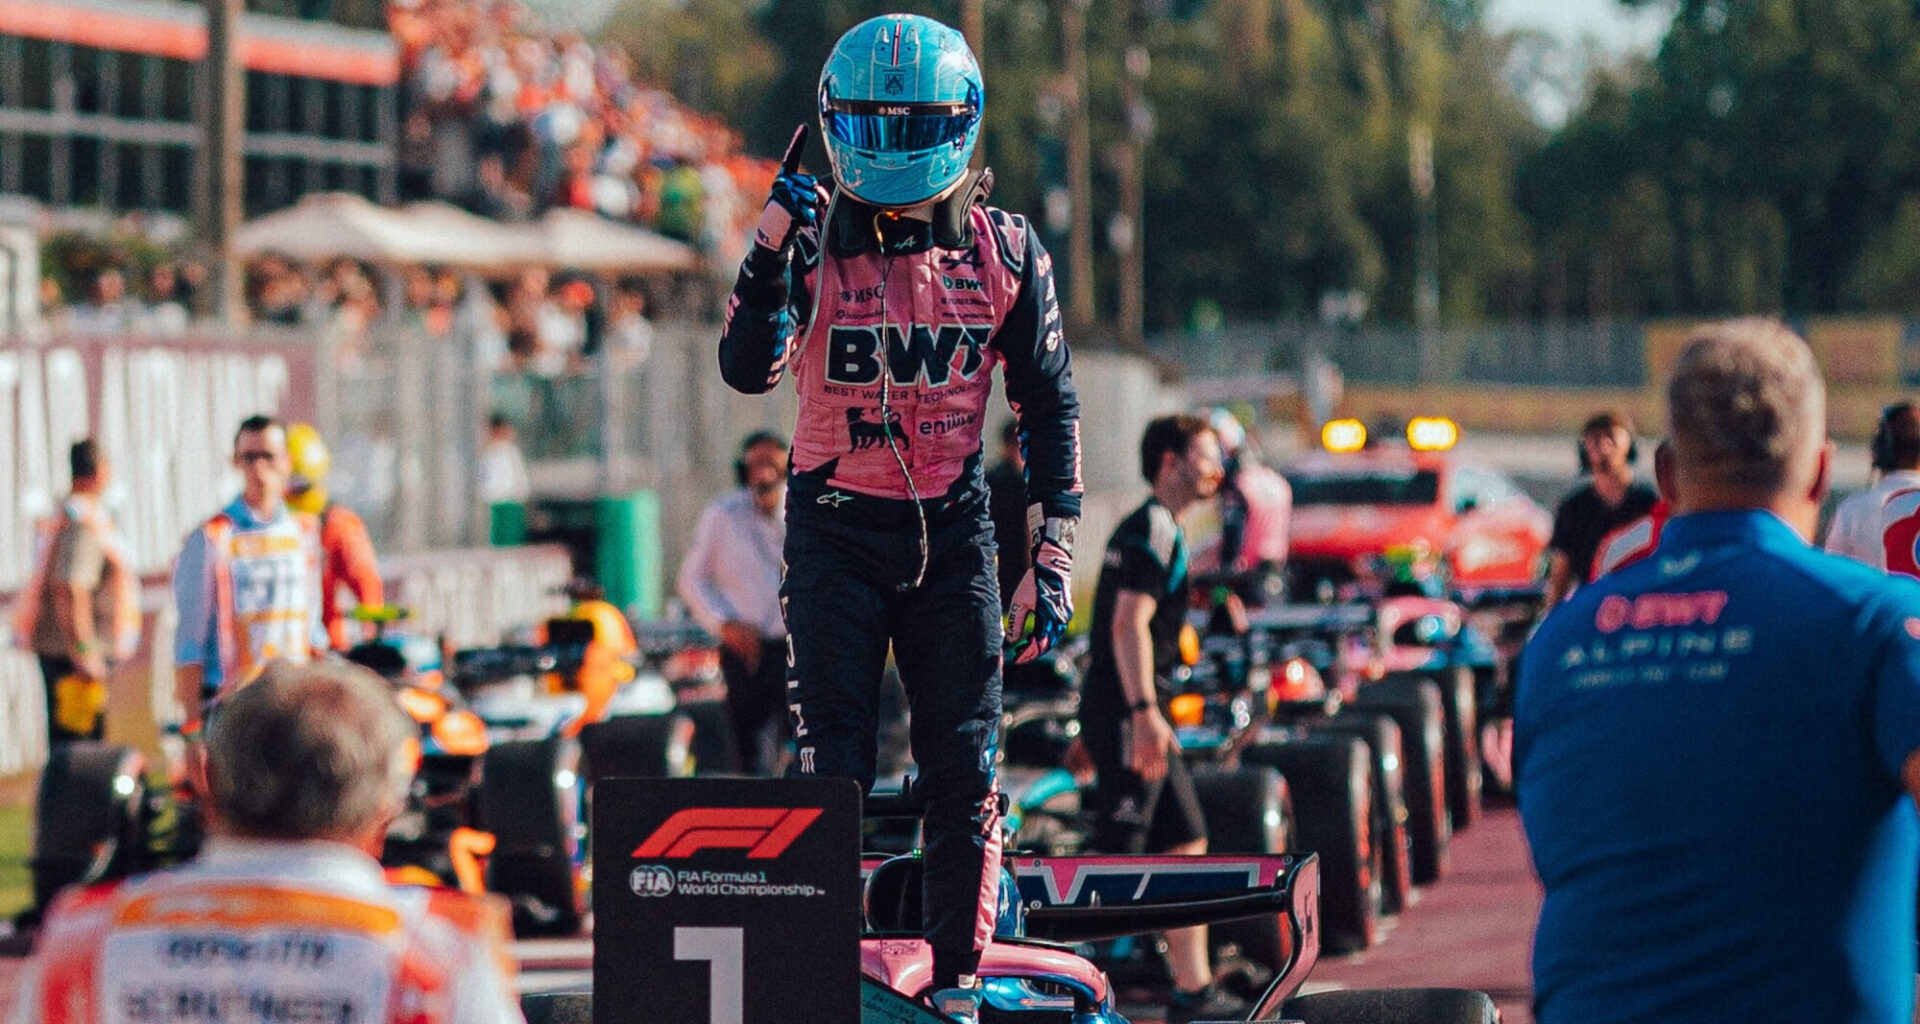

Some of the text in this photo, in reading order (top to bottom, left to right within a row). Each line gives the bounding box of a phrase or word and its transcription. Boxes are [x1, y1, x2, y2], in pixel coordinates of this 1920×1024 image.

[887, 106, 911, 116] MSC
[825, 324, 994, 387] BWT
[824, 385, 857, 399] BEST
[861, 389, 909, 401] WAER
[677, 871, 767, 883] FIA Formula 1
[677, 883, 719, 895] World
[720, 883, 815, 897] Championship
[673, 926, 744, 1024] 1
